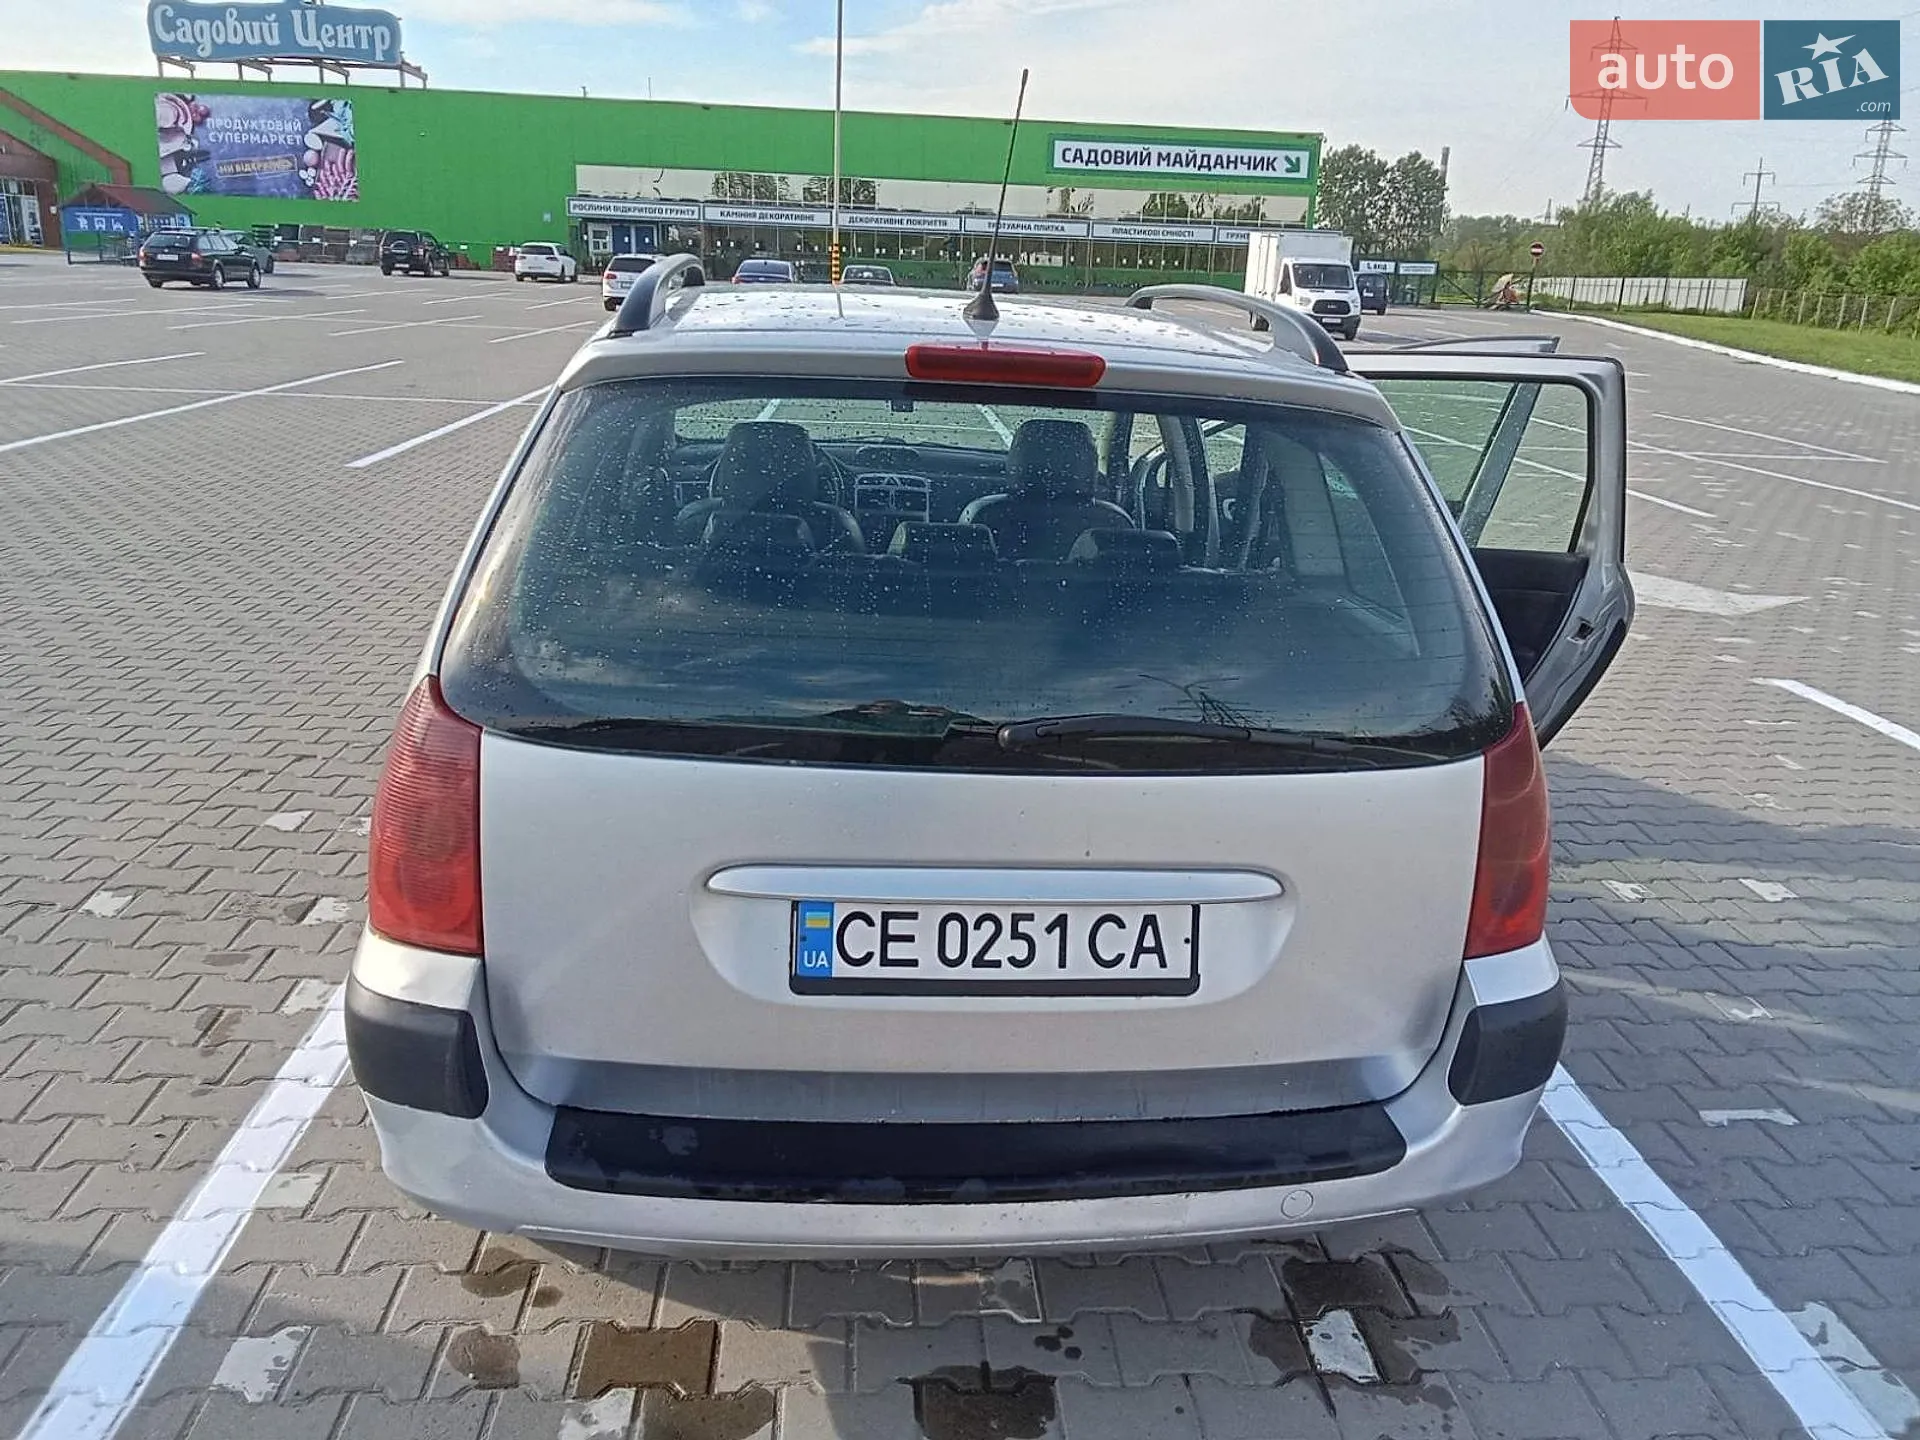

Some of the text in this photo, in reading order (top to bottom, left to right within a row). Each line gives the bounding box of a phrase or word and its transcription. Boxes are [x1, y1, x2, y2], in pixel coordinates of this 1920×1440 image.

[153, 4, 391, 61] Садовий Центр
[207, 117, 302, 132] ПРОДУКТОВИЙ
[208, 131, 301, 145] СУПЕРМАРКЕТ
[1061, 147, 1277, 172] САДОВИЙ МАЙДАНЧИК
[835, 910, 1168, 969] CE 0251 CA
[803, 949, 828, 968] UA
